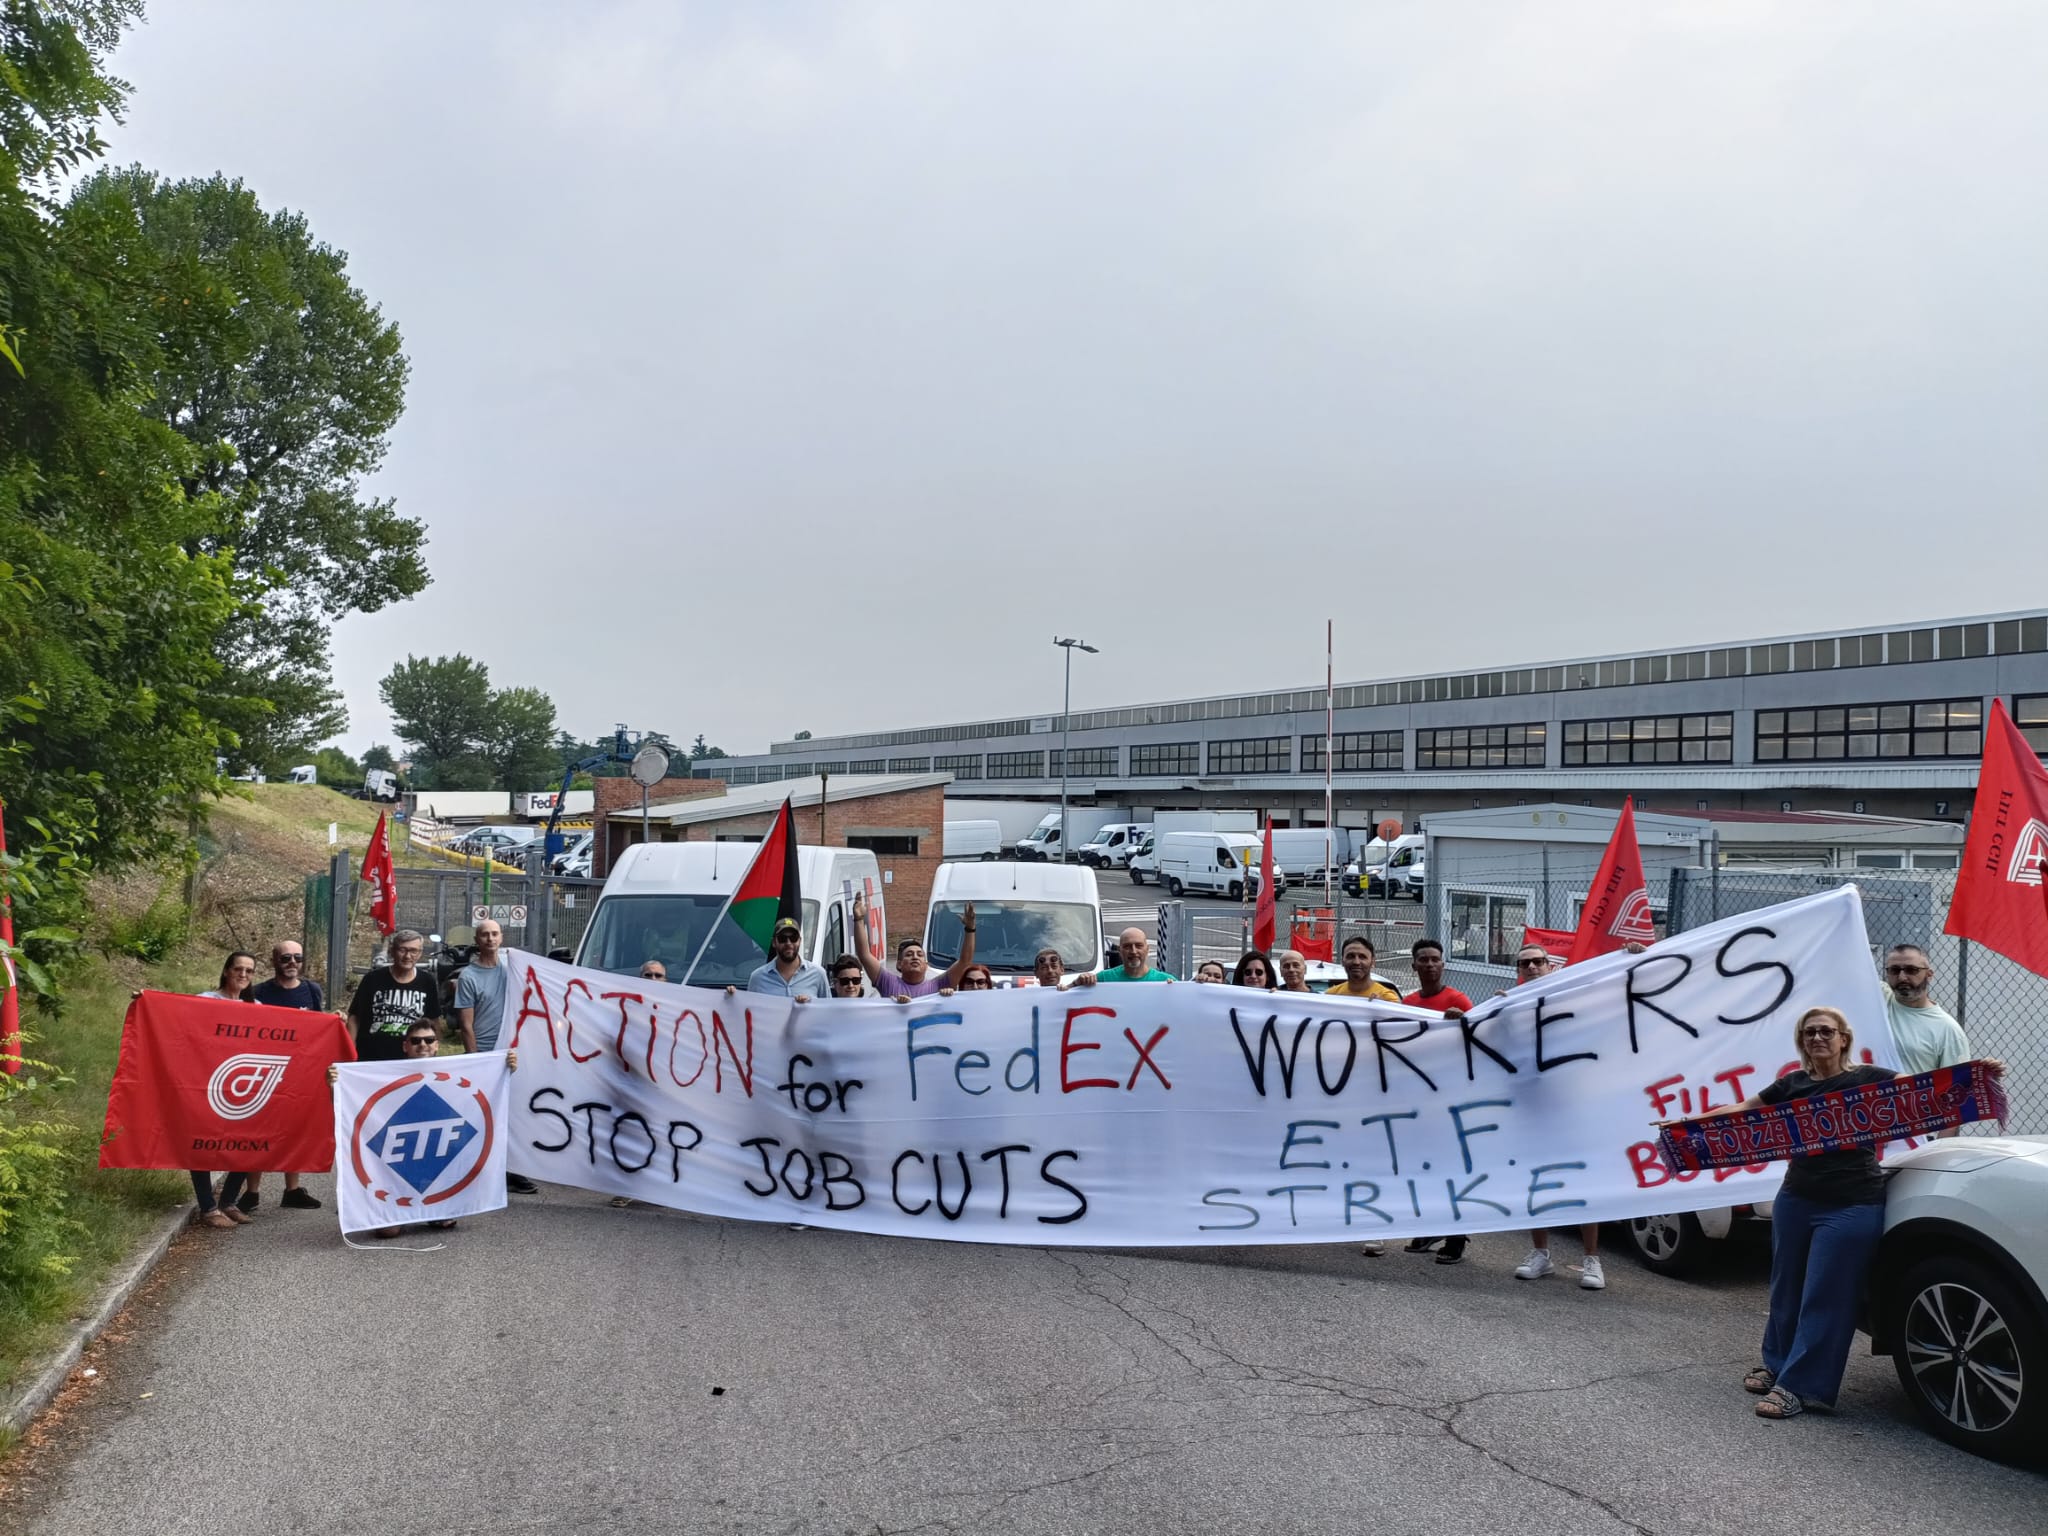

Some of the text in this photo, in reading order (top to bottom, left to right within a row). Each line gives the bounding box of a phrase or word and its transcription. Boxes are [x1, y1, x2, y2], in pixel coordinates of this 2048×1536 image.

[531, 794, 558, 809] FedE
[1783, 802, 1791, 811] 9
[1856, 803, 1864, 813] 8
[1937, 803, 1946, 814] 7
[215, 1023, 298, 1042] FILT CGIL
[777, 1054, 863, 1113] for
[907, 1006, 1172, 1101] FedEx
[1229, 926, 1794, 1099] WORKERS
[1703, 1118, 1795, 1157] FORZA
[1795, 1086, 1943, 1144] BOLOGNA
[1740, 1114, 1757, 1123] LA
[1760, 1107, 1795, 1119] GIOIA
[1799, 1098, 1840, 1112] DELLA
[1844, 1082, 1911, 1102] VITTORIA
[192, 1138, 270, 1151] BOLOGNA
[381, 1117, 467, 1164] ETF
[529, 1087, 1089, 1225] STOP JOB CUTS
[1279, 1099, 1518, 1175] E.T.F.
[1707, 1154, 1751, 1166] GLORIOSI
[1751, 1149, 1788, 1161] NOSTRI
[1789, 1142, 1825, 1154] COLORI
[1827, 1125, 1912, 1147] SPLENDERANNO
[1914, 1113, 1959, 1131] SEMPRE
[1198, 1161, 1589, 1231] STRIKE
